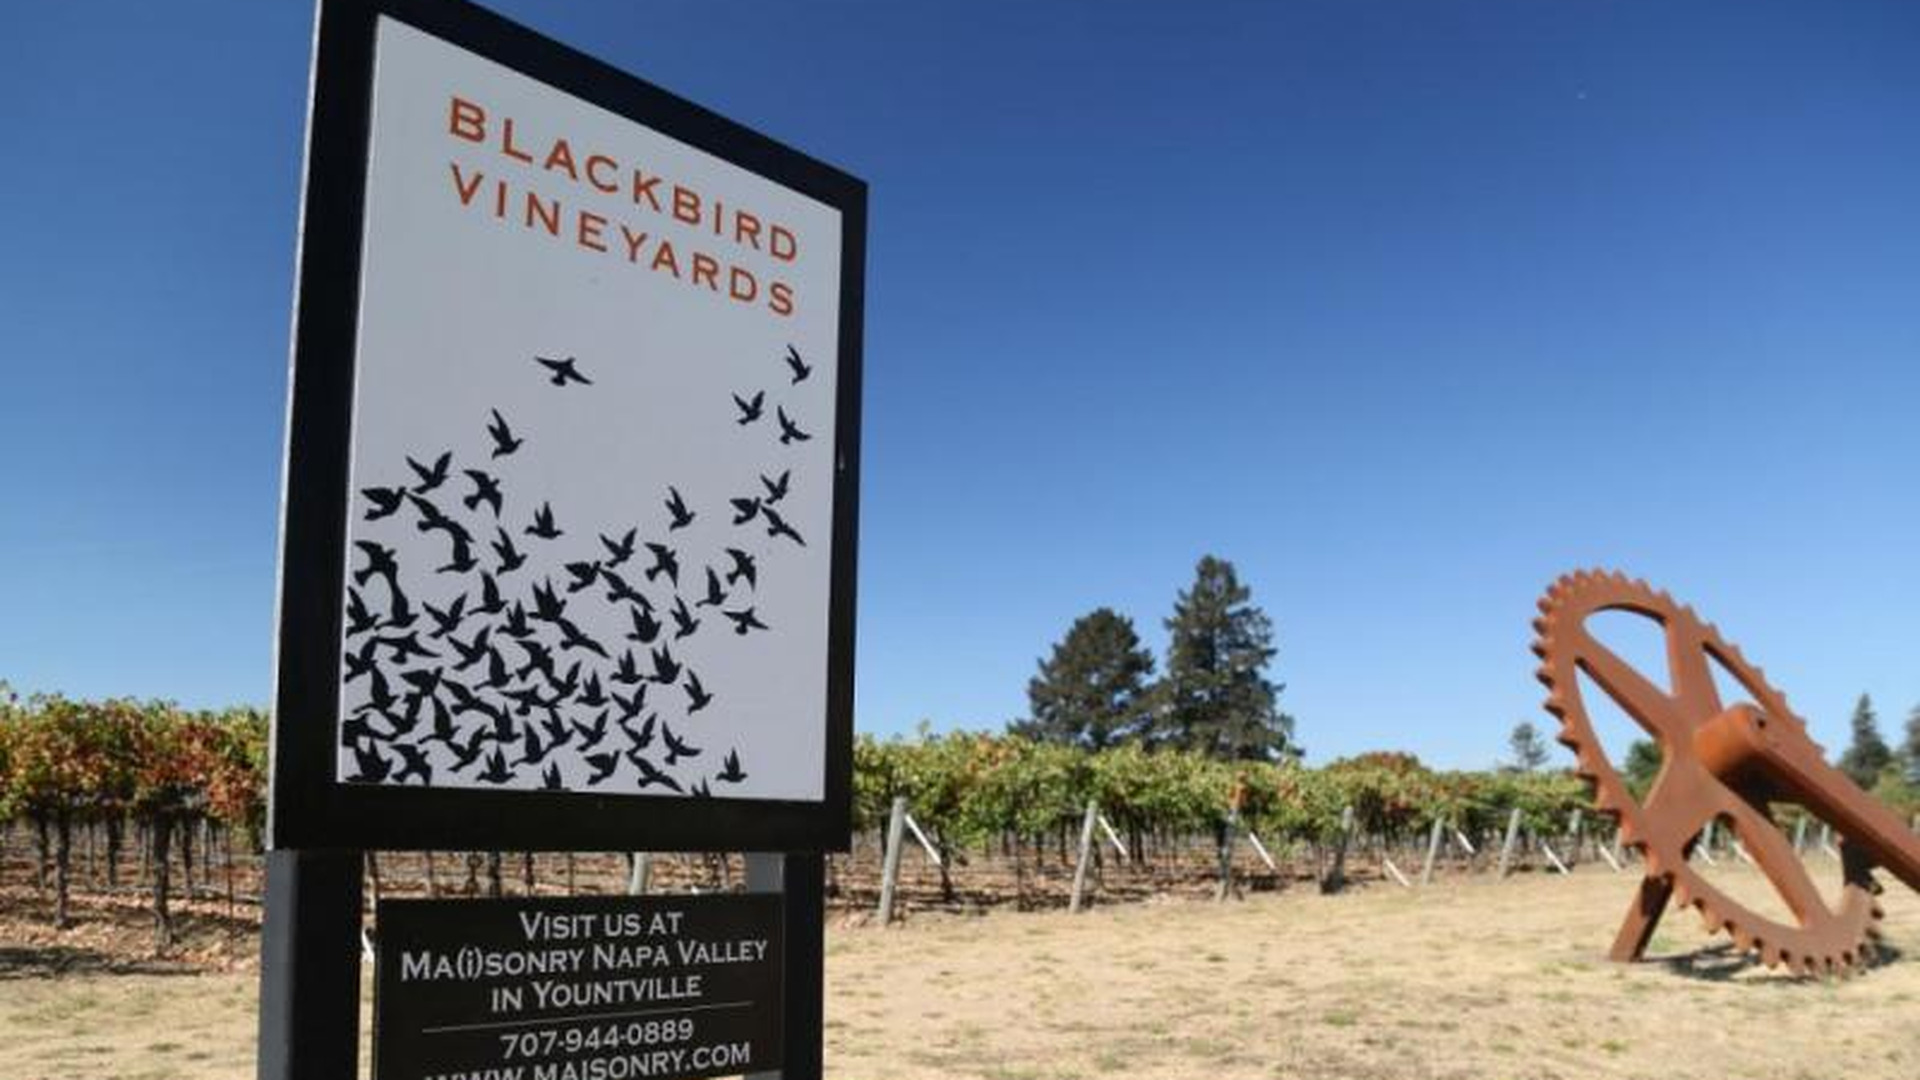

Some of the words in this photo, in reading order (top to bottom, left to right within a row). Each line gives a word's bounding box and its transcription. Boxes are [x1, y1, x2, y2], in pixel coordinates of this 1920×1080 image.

[449, 97, 797, 262] BLACKBIRD
[450, 163, 794, 316] VINEYARDS
[593, 943, 670, 970] NAPA
[677, 939, 767, 965] VALLEY
[532, 976, 702, 1009] YOUNTVILLE
[500, 1018, 694, 1059] 707-944-0889
